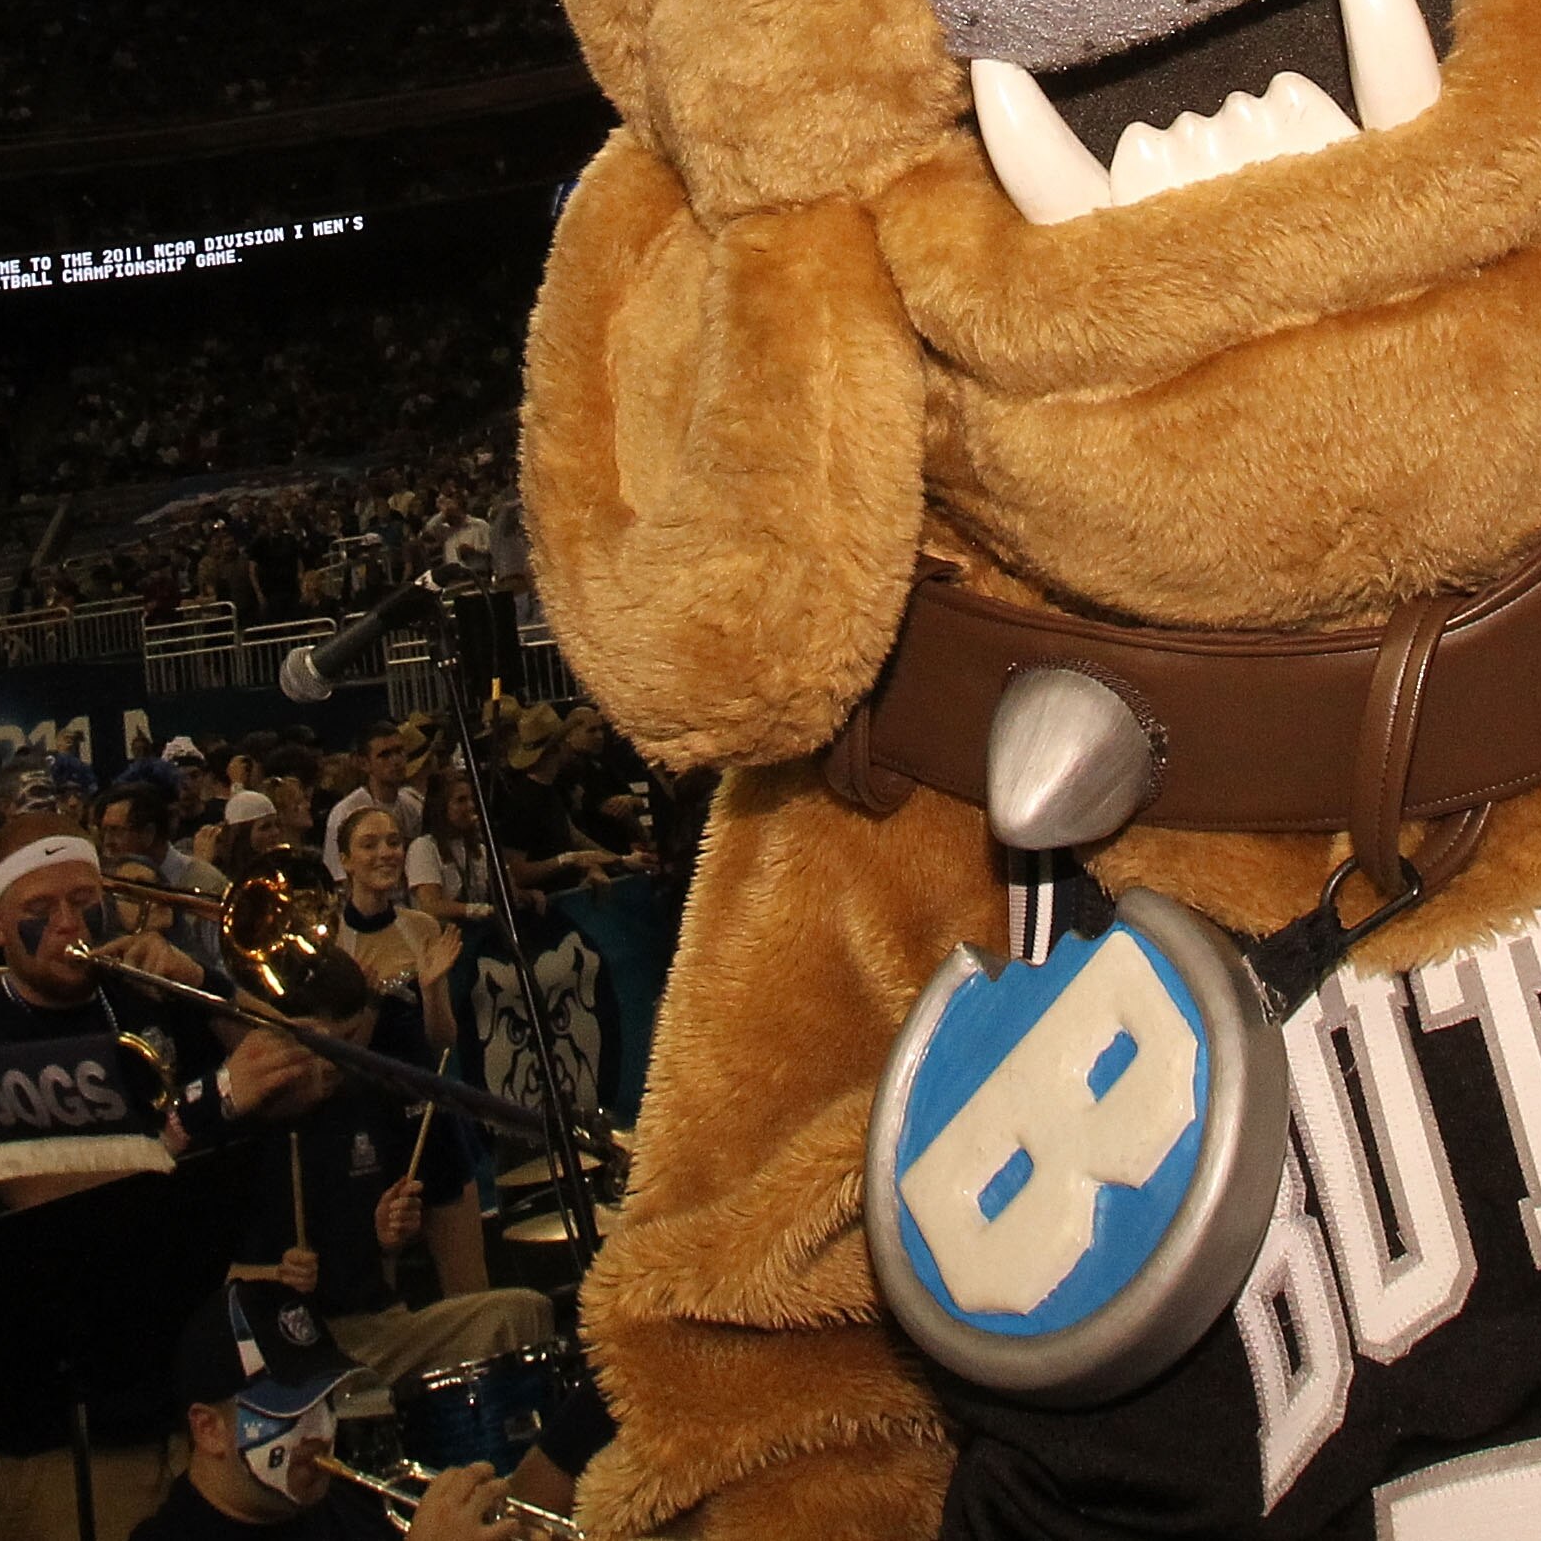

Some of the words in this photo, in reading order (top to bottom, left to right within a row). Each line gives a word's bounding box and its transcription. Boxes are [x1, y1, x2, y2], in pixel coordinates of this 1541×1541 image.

[29, 256, 52, 272] TO
[60, 251, 93, 269] THE
[102, 246, 143, 264] 2011
[153, 240, 196, 259] NCAA
[204, 226, 285, 253] DIVISION
[293, 224, 304, 240] I
[312, 215, 364, 237] MEN'S
[61, 256, 187, 284] CHAMPIONSHIP
[195, 249, 243, 268] GAME.
[898, 930, 1198, 1316] B
[269, 1445, 285, 1469] B
